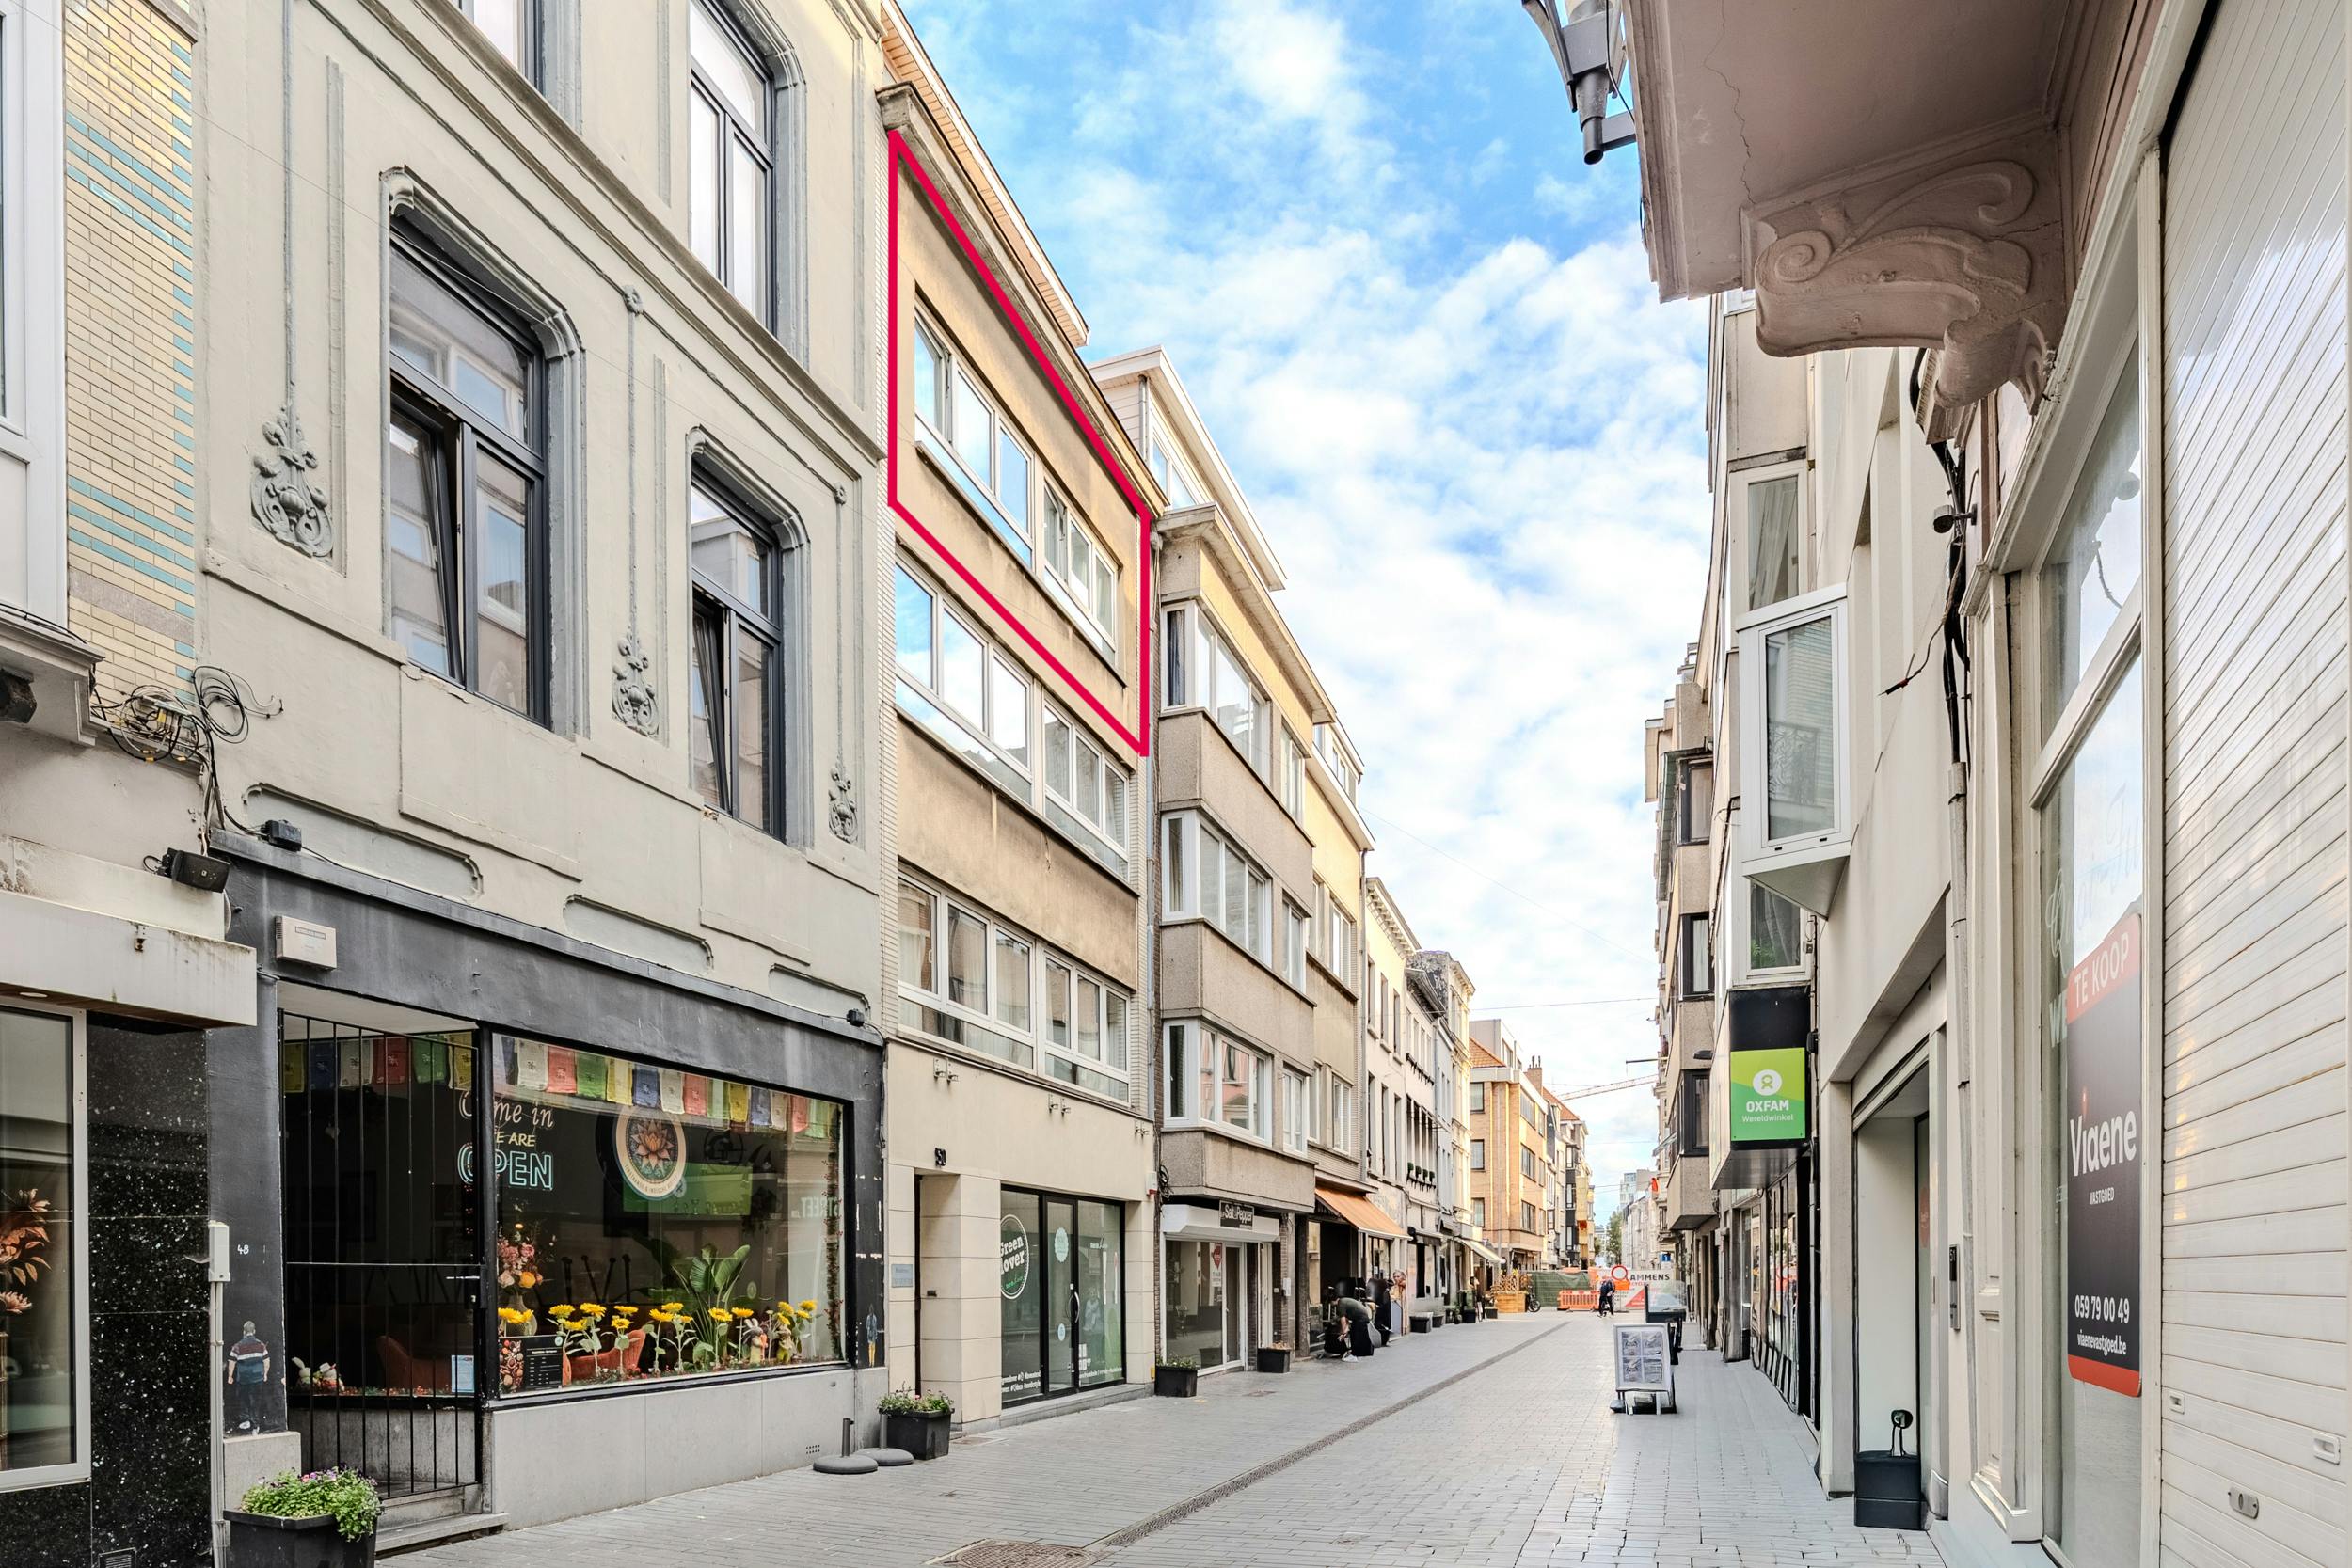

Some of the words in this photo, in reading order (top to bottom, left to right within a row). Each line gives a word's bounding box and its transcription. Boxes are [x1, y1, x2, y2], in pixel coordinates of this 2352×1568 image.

[2074, 967, 2089, 1009] TE
[2091, 932, 2130, 997] KOOP
[532, 1099, 554, 1128] in
[1745, 1099, 1789, 1113] OXFAM
[1741, 1114, 1794, 1123] Wereldwinkel
[508, 1132, 536, 1147] ARE
[2070, 1110, 2137, 1177] Viaene
[934, 1147, 946, 1167] 50
[2089, 1187, 2115, 1205] VASTGOED
[237, 1243, 249, 1255] 48
[1629, 1273, 1670, 1281] AMMENS
[2074, 1294, 2090, 1319] 059
[2090, 1295, 2102, 1321] 79
[2103, 1296, 2116, 1323] 00
[2117, 1297, 2130, 1324] 49
